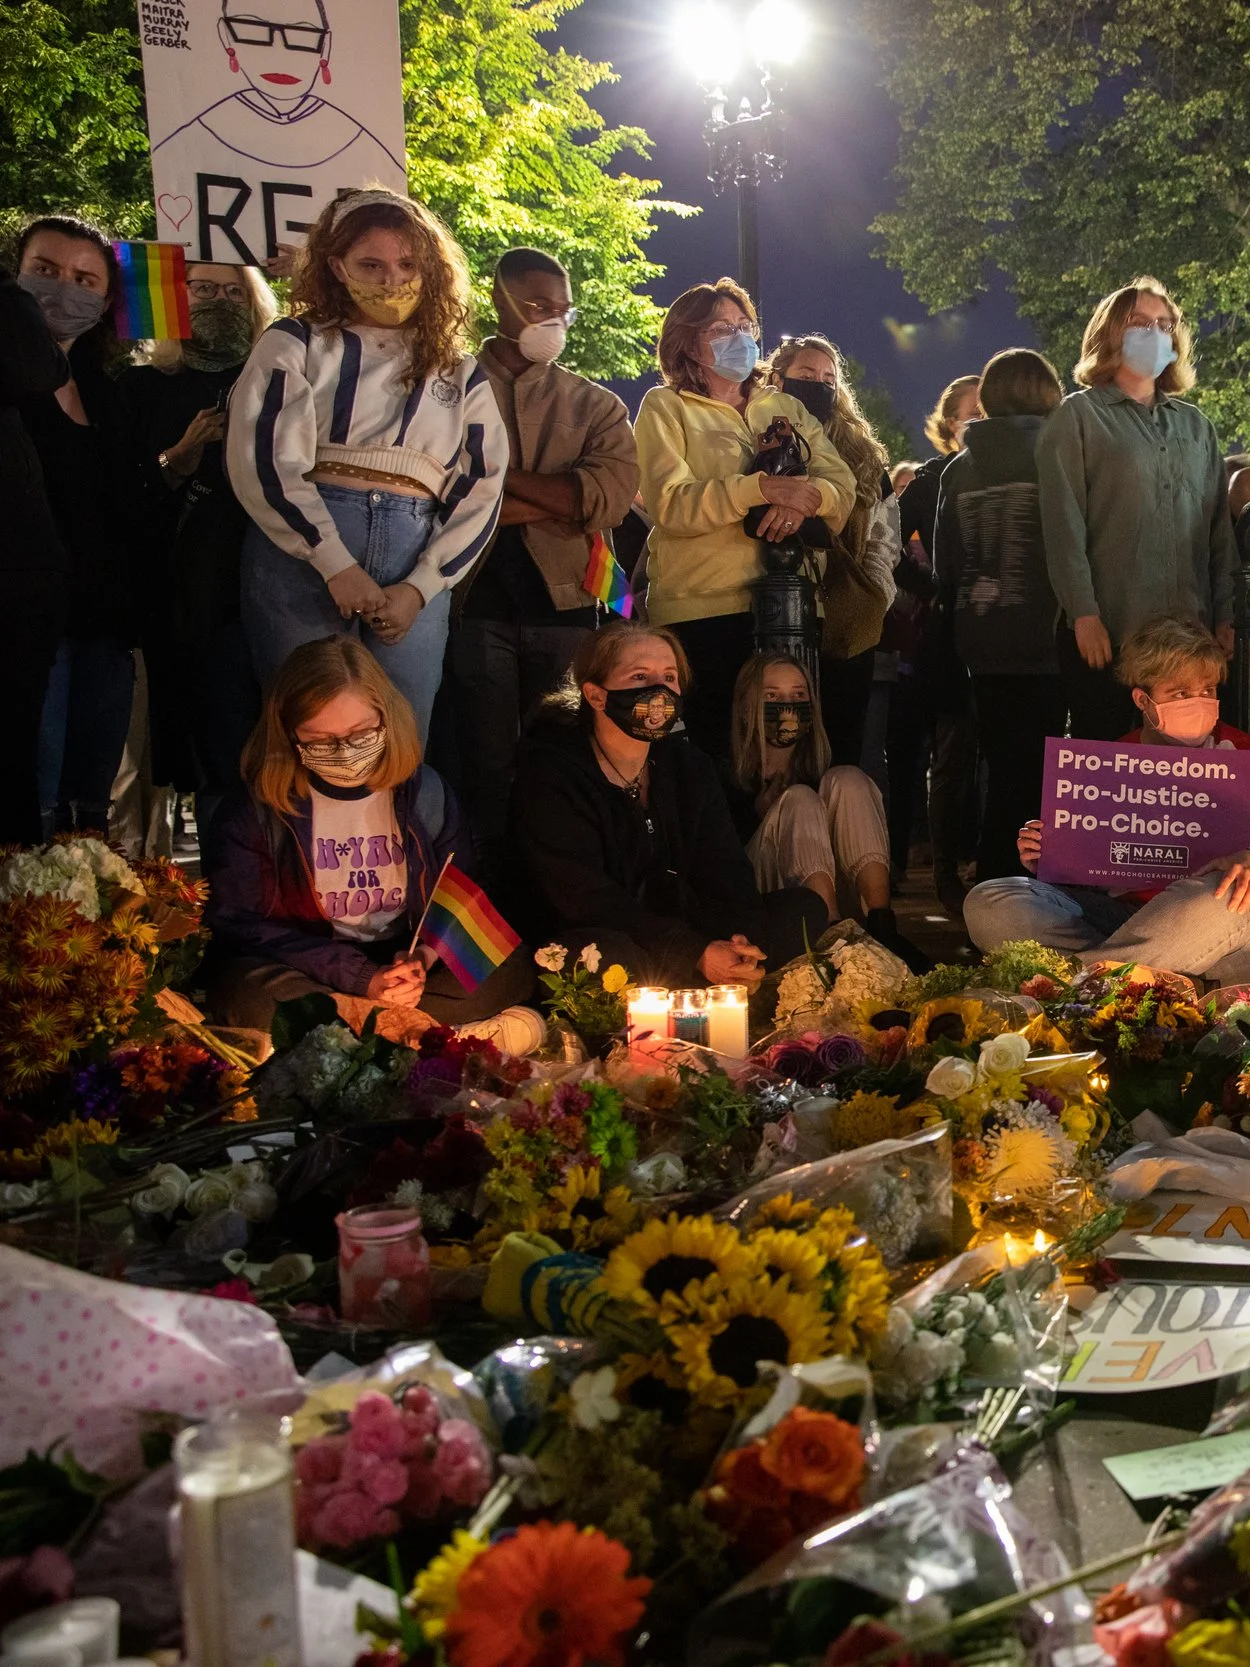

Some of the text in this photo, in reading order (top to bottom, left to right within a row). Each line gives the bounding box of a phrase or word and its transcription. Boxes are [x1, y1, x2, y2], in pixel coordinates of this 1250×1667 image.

[142, 2, 184, 19] MAITRA
[142, 15, 189, 31] MURRAY
[144, 24, 181, 40] SEELY
[144, 34, 191, 50] GERBER
[197, 173, 357, 268] RE
[1058, 749, 1236, 780] Pro-Freedom.
[1056, 779, 1217, 809] Pro-Justice.
[1054, 809, 1209, 838] Pro-Choice.
[1133, 847, 1183, 860] NARAL
[348, 870, 380, 888] FOR
[316, 887, 401, 918] HOIC
